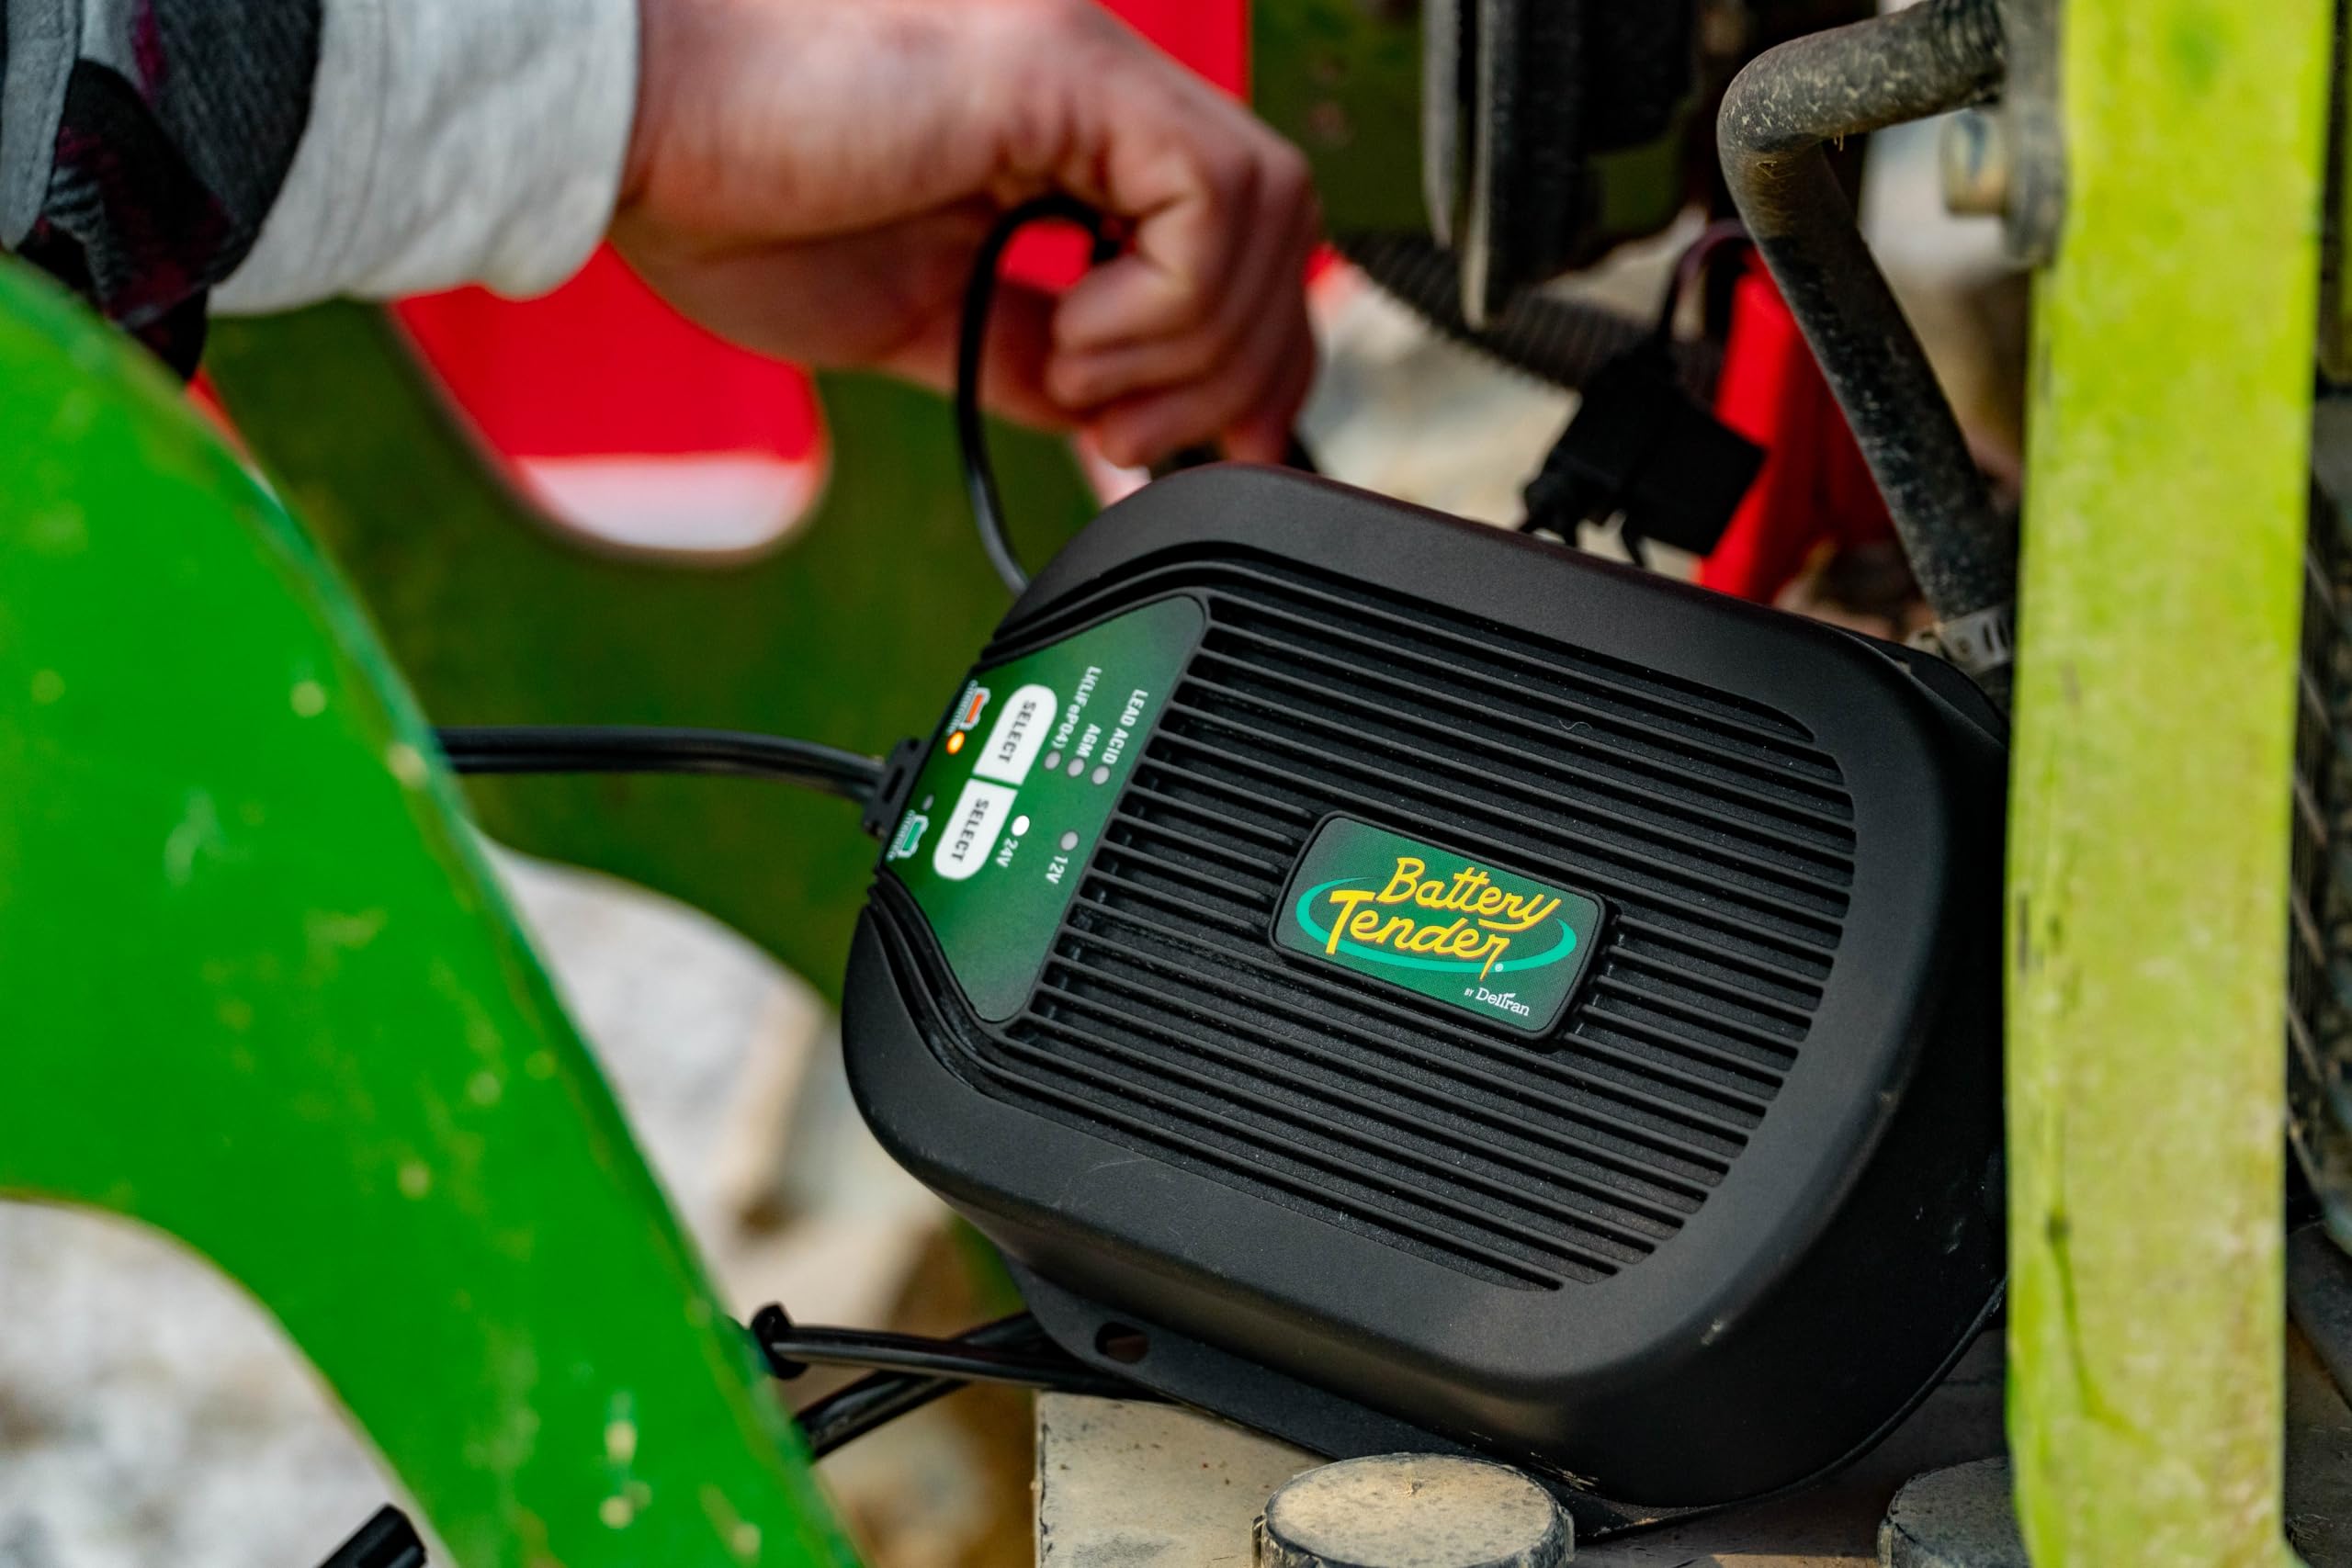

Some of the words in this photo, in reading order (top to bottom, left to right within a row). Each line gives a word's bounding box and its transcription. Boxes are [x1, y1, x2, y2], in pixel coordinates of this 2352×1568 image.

[1120, 689, 1148, 727] LEAD
[998, 700, 1036, 763] SELECT
[1076, 724, 1101, 758] AGM
[1102, 728, 1128, 764] ACID
[951, 798, 989, 863] SELECT
[996, 838, 1019, 867] 24V
[1046, 856, 1069, 884] 12V
[1376, 856, 1561, 931] Battery
[1324, 890, 1510, 981] Tender
[1464, 987, 1475, 997] BY
